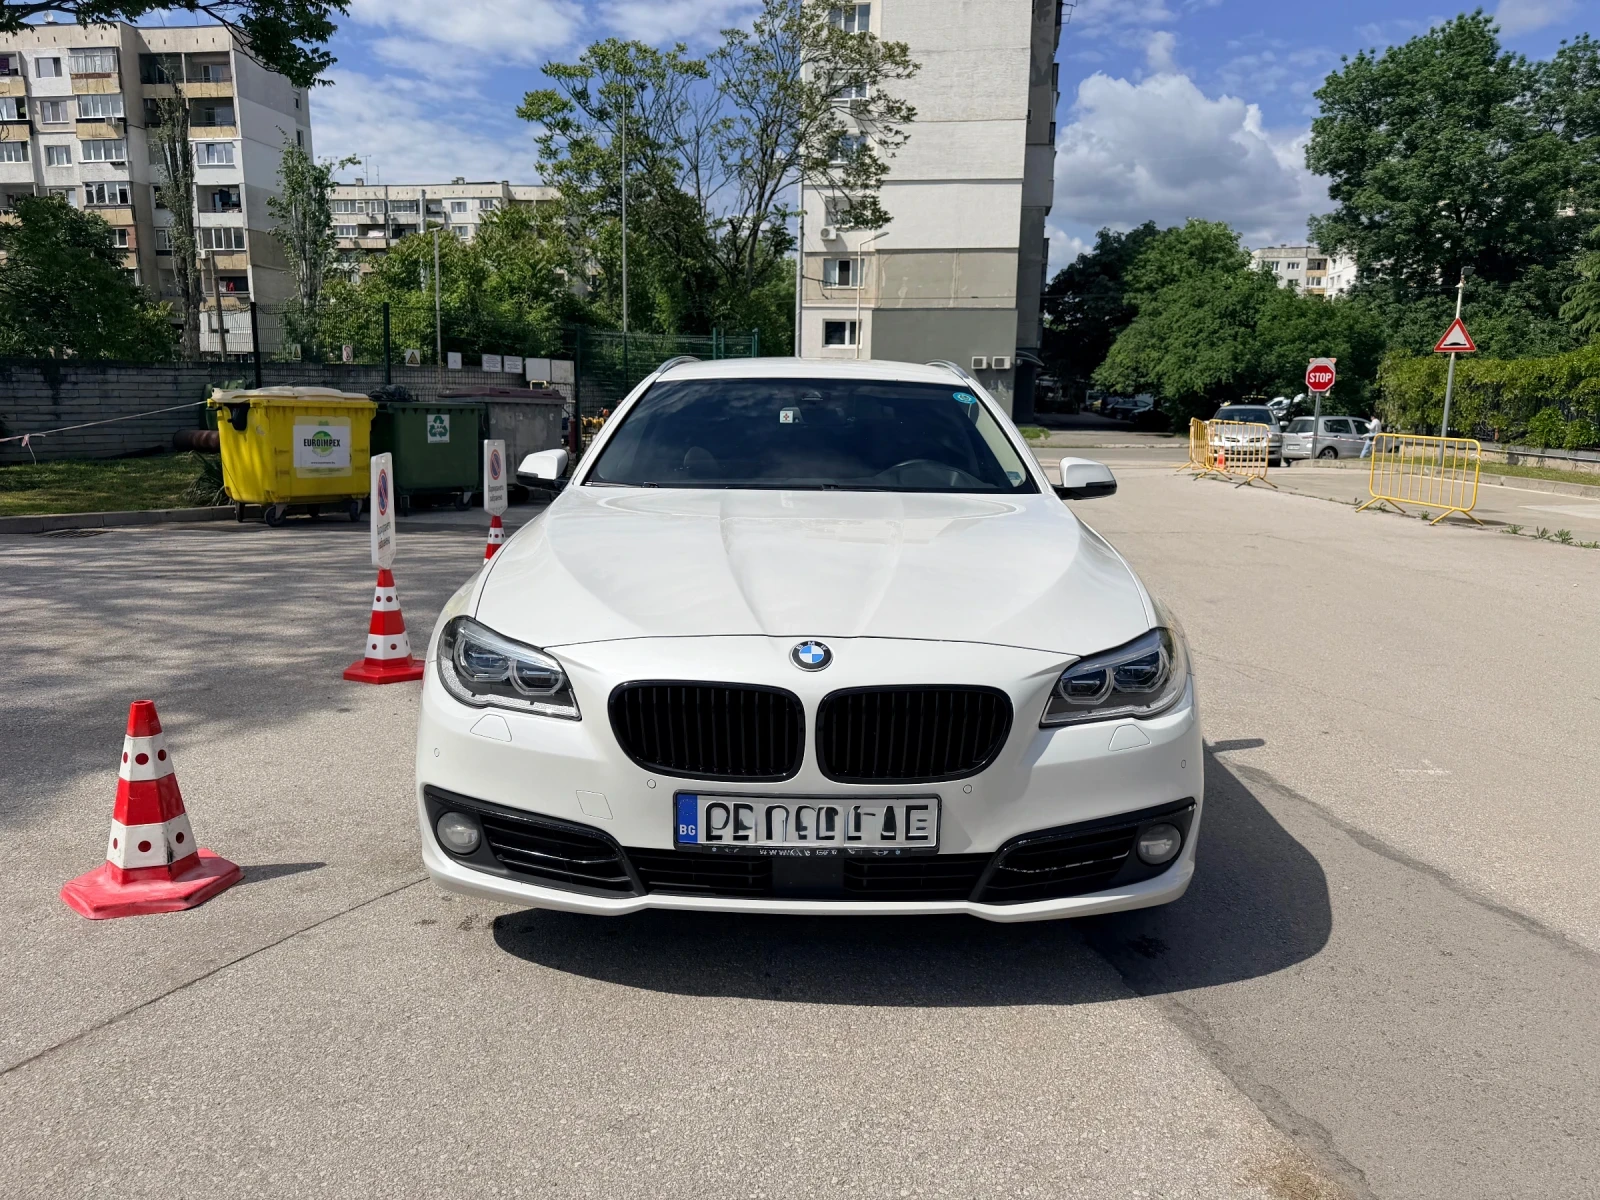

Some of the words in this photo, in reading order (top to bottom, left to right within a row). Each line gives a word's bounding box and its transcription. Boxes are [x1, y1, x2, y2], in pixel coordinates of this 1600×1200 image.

[1309, 372, 1332, 383] STOP
[303, 438, 341, 447] EUROIMPEX
[796, 640, 828, 650] BMW
[679, 824, 696, 836] BG
